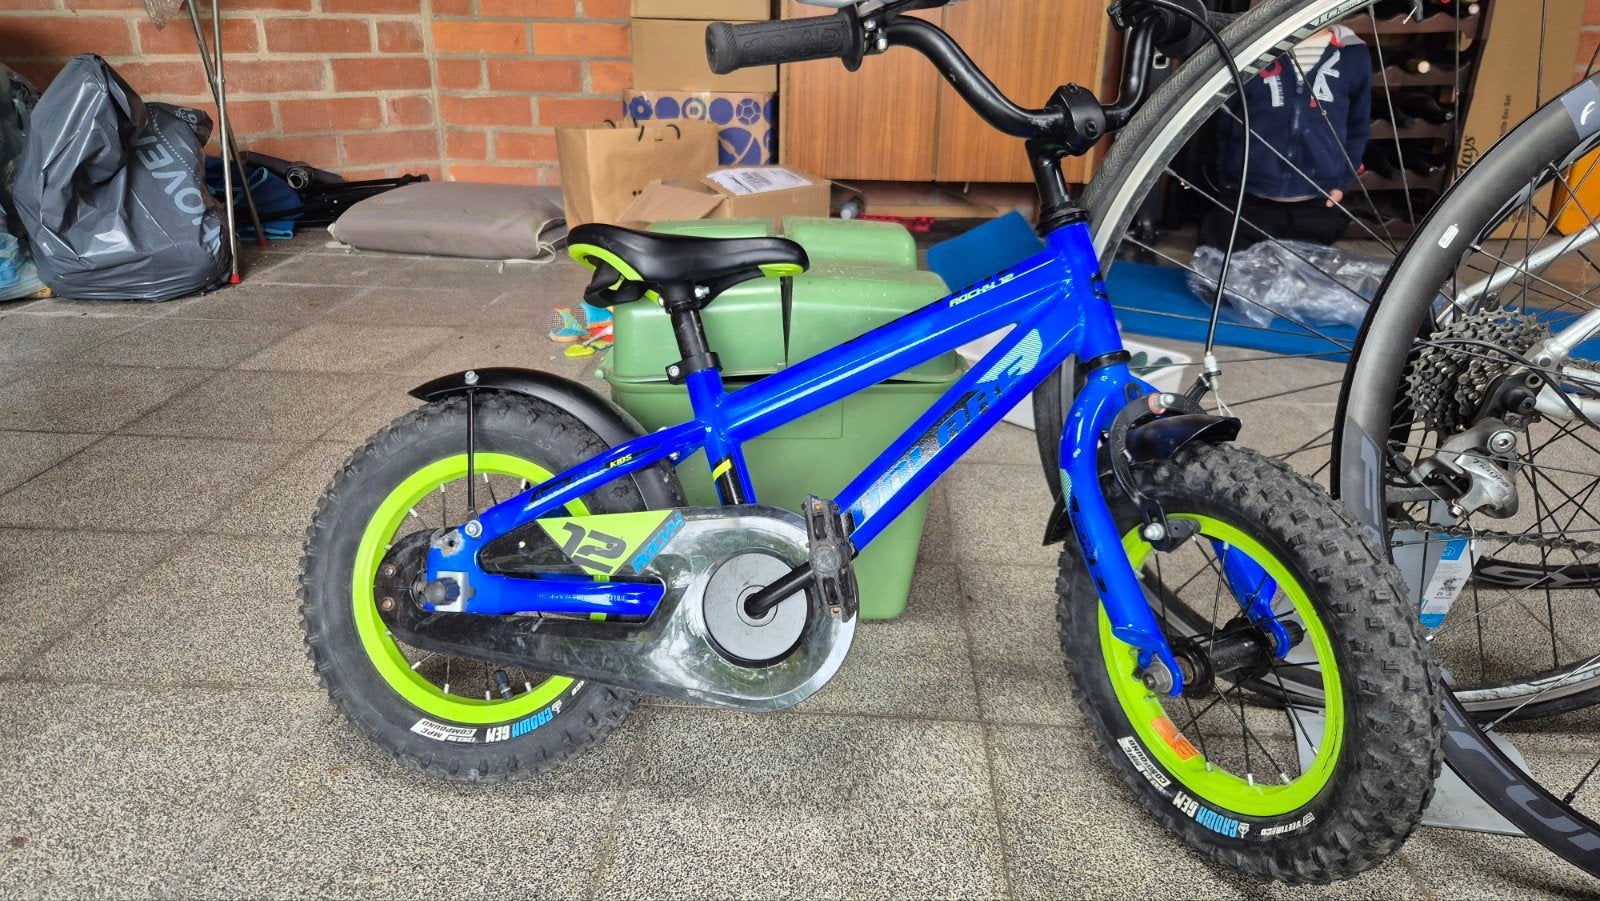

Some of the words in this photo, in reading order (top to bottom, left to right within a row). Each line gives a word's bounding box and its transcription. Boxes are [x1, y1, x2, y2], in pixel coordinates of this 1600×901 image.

[949, 282, 995, 308] ROCKY
[999, 272, 1015, 286] 12
[609, 453, 632, 468] KIDS
[562, 522, 627, 574] 12
[631, 512, 685, 574] ROCKY
[420, 728, 443, 740] MPC
[421, 719, 473, 737] COMPOUND
[486, 725, 510, 743] GEM
[511, 706, 553, 739] CROWN
[1128, 739, 1168, 785] COMPOUND
[1172, 790, 1199, 818] GEM
[1194, 805, 1239, 838] CROWN
